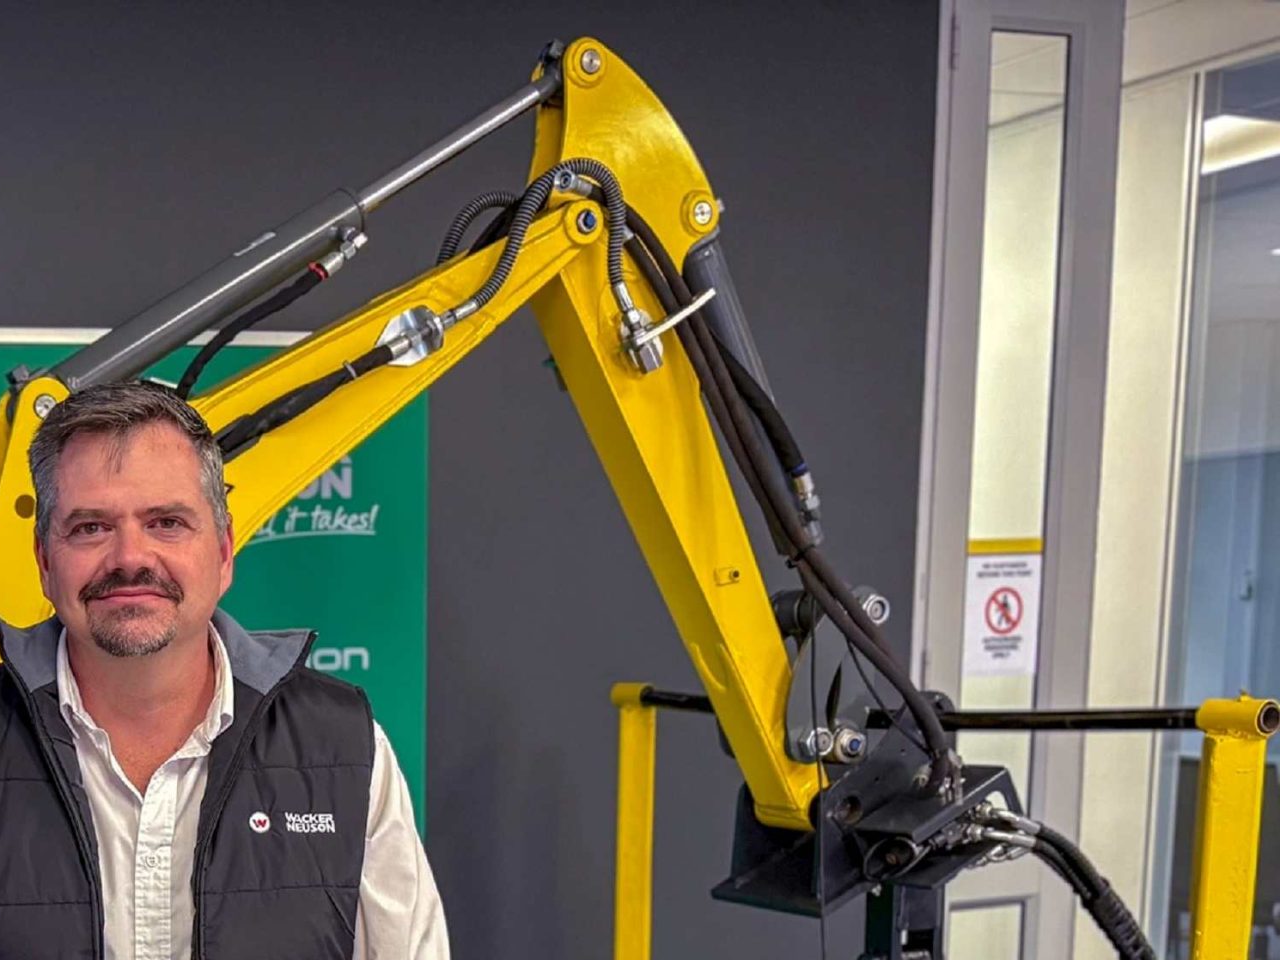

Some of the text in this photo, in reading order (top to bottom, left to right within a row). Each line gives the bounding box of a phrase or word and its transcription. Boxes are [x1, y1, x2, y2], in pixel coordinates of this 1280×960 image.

[284, 505, 308, 533] it
[311, 504, 380, 533] takes!
[284, 811, 333, 824] WACKER
[285, 821, 336, 833] NEUSON
